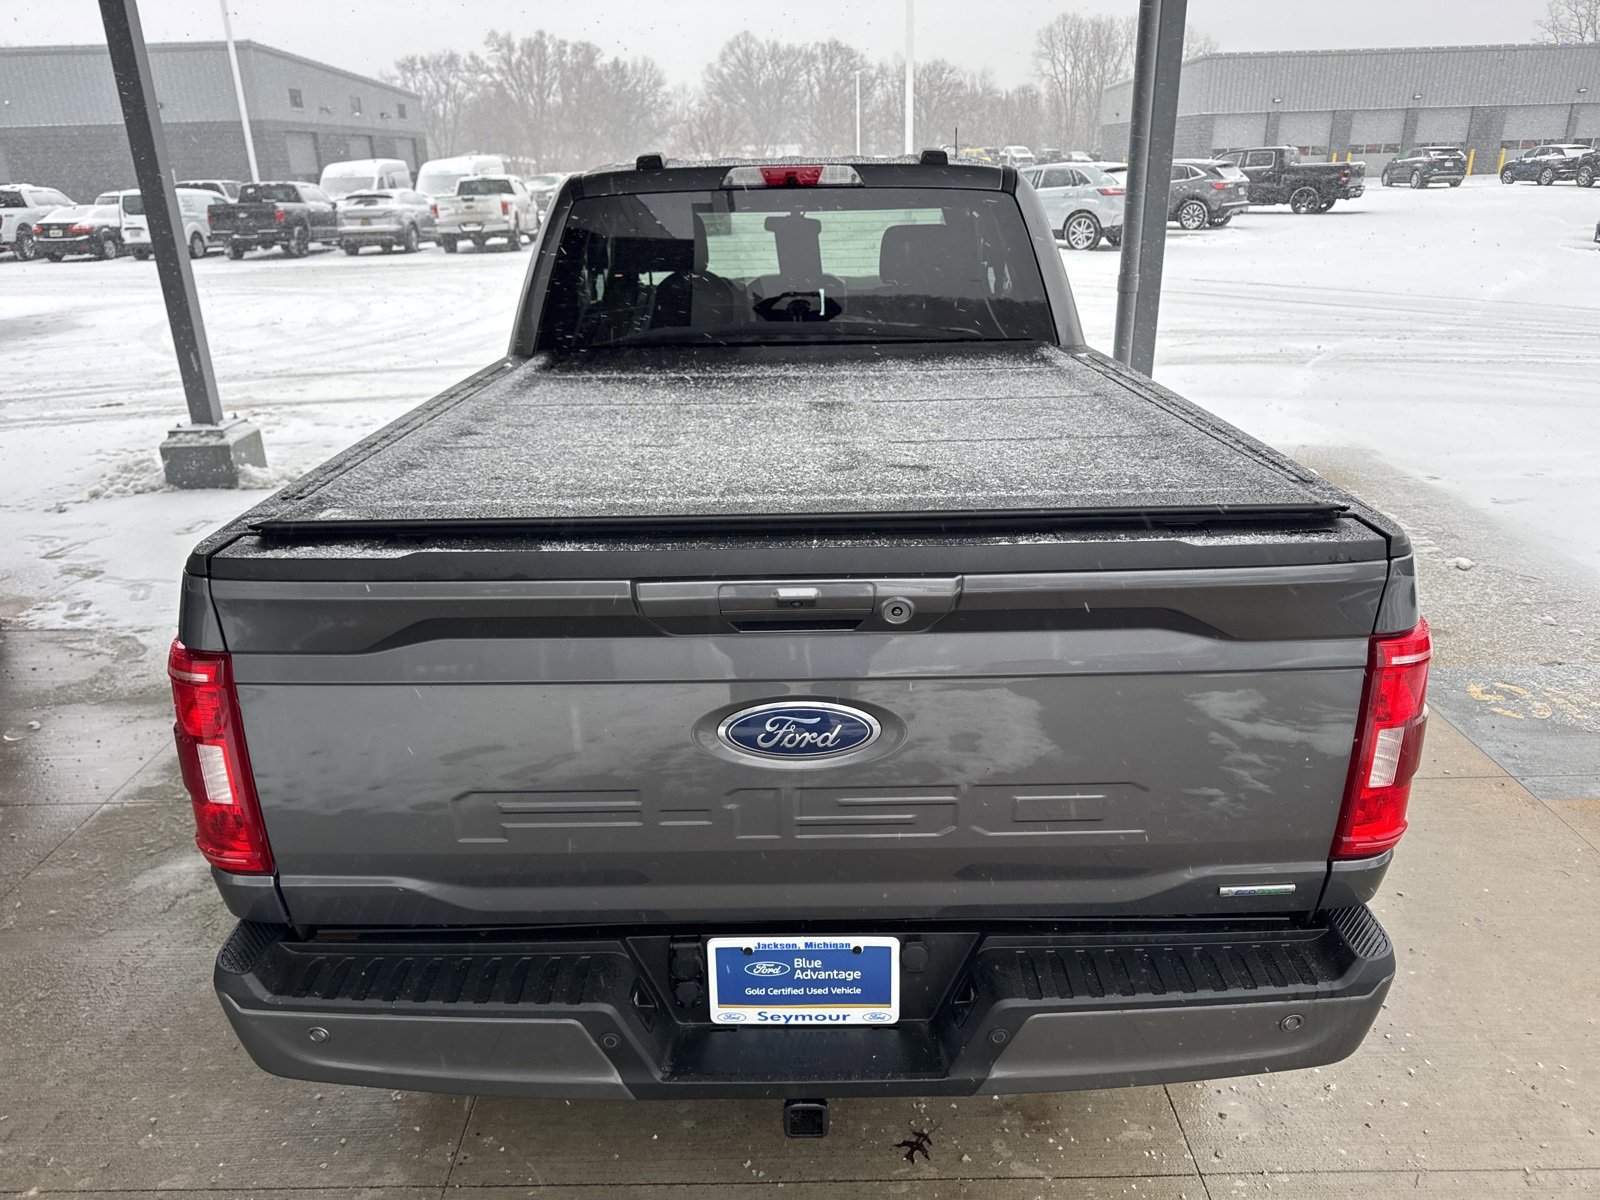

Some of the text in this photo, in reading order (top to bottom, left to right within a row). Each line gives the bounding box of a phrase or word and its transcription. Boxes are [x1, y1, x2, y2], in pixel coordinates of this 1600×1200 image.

[756, 715, 842, 749] Ford
[453, 782, 1150, 843] F-150
[752, 963, 781, 974] Ford
[794, 958, 822, 968] Blue
[794, 969, 861, 980] Advantage
[745, 986, 861, 995] Gold Certified Used Vehicle
[757, 1011, 851, 1024] Seymour
